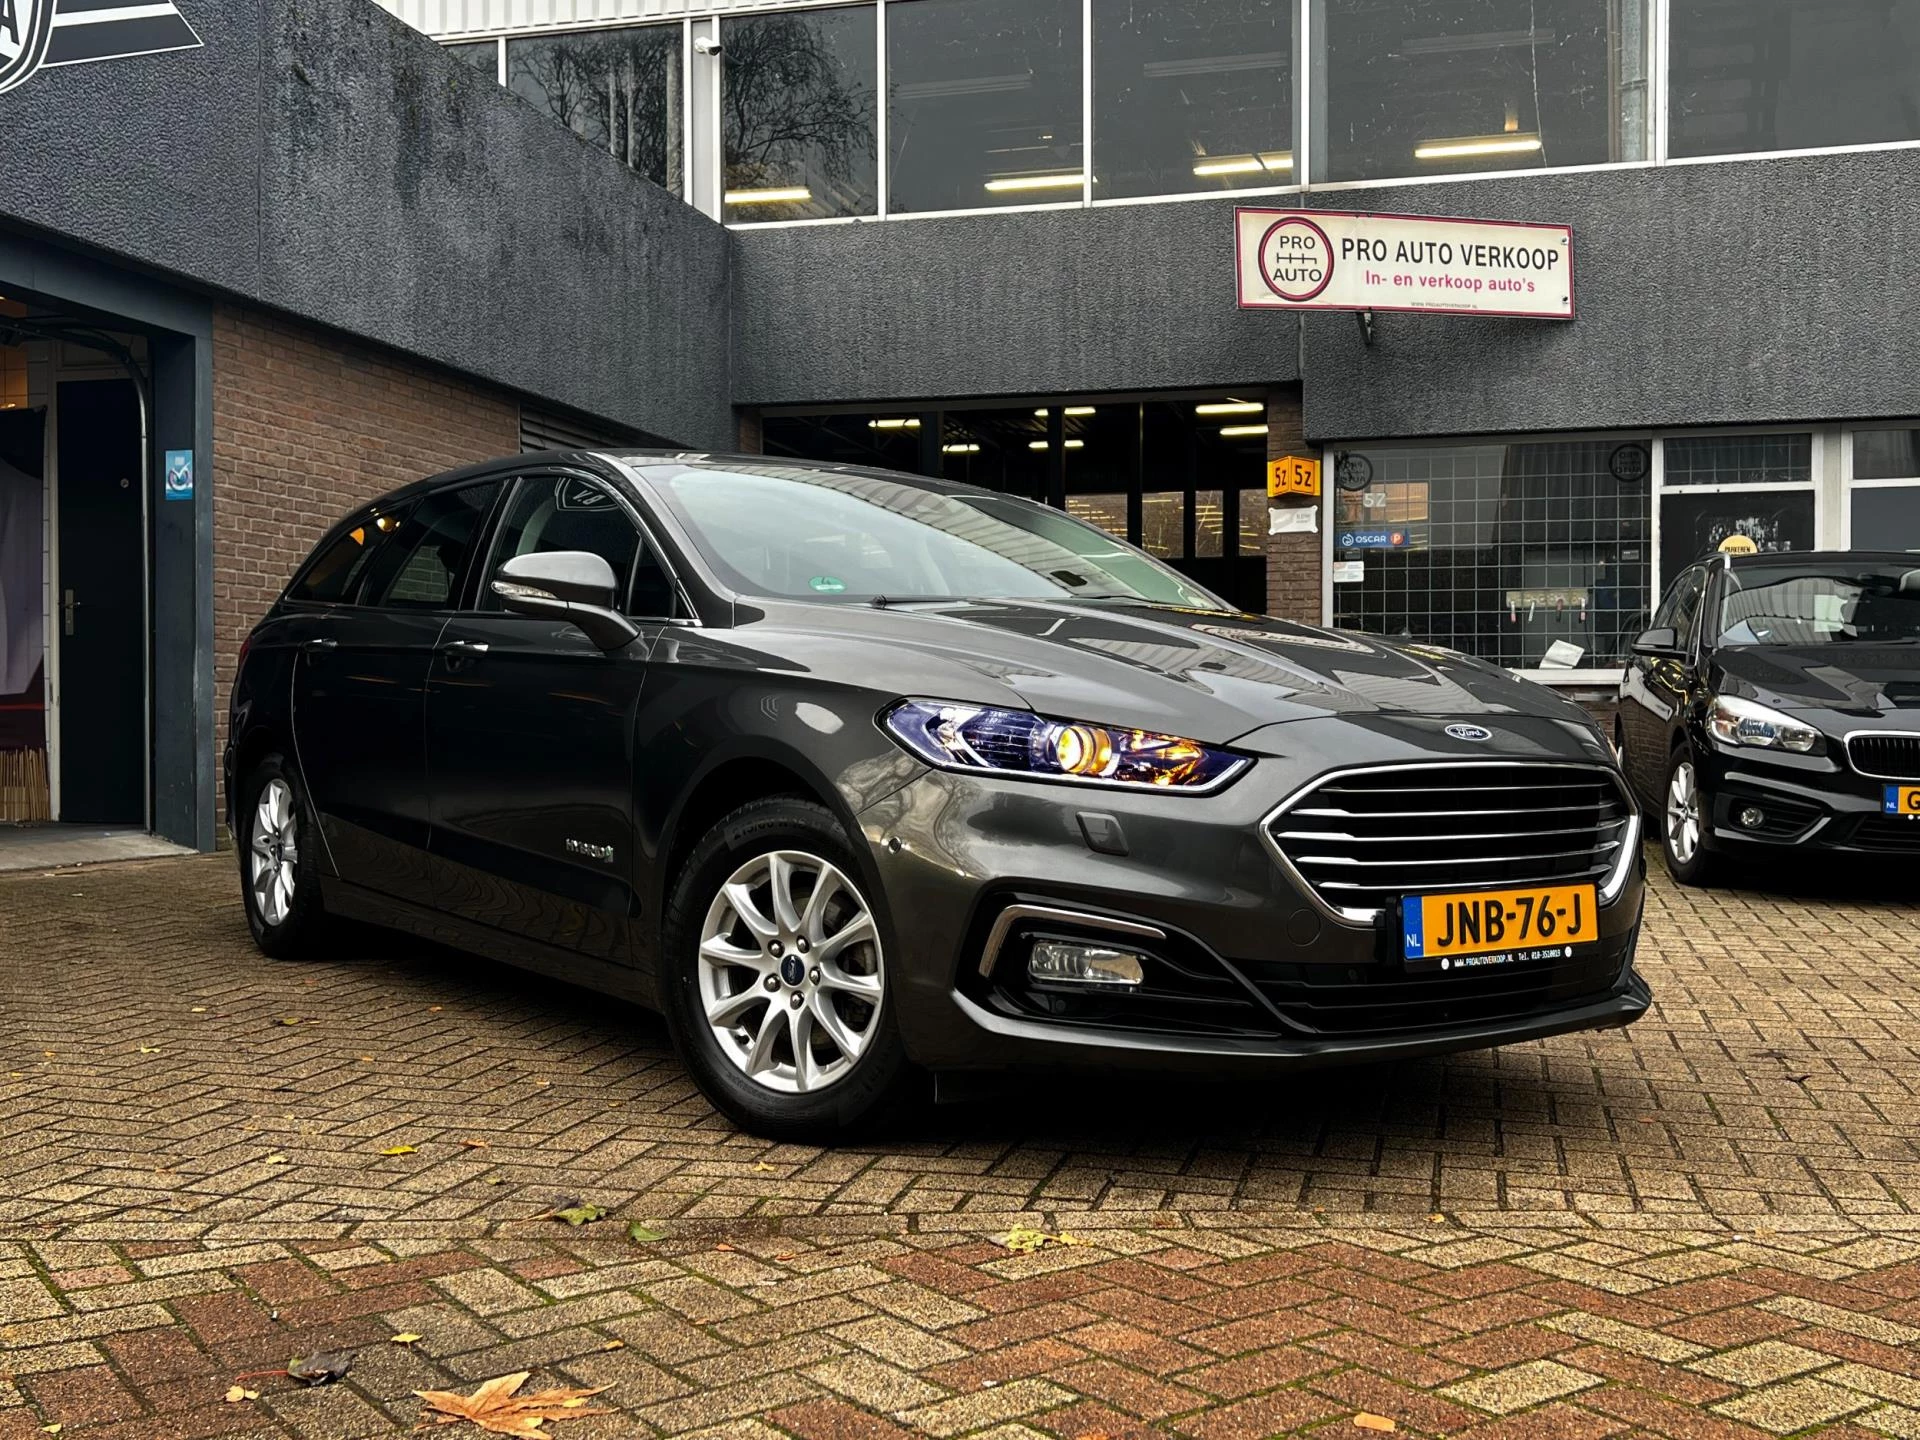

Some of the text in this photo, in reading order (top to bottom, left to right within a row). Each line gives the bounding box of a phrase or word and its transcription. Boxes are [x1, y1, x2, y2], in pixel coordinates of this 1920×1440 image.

[1279, 235, 1316, 250] PRO
[1341, 237, 1560, 271] PRO AUTO VERKOOP
[1272, 267, 1323, 283] AUTO
[1365, 269, 1536, 293] In- en verkoop auto's
[1355, 535, 1387, 543] OSCAR
[1886, 801, 1897, 809] NL
[1436, 893, 1582, 947] JNB-76-J
[1406, 933, 1421, 948] NL
